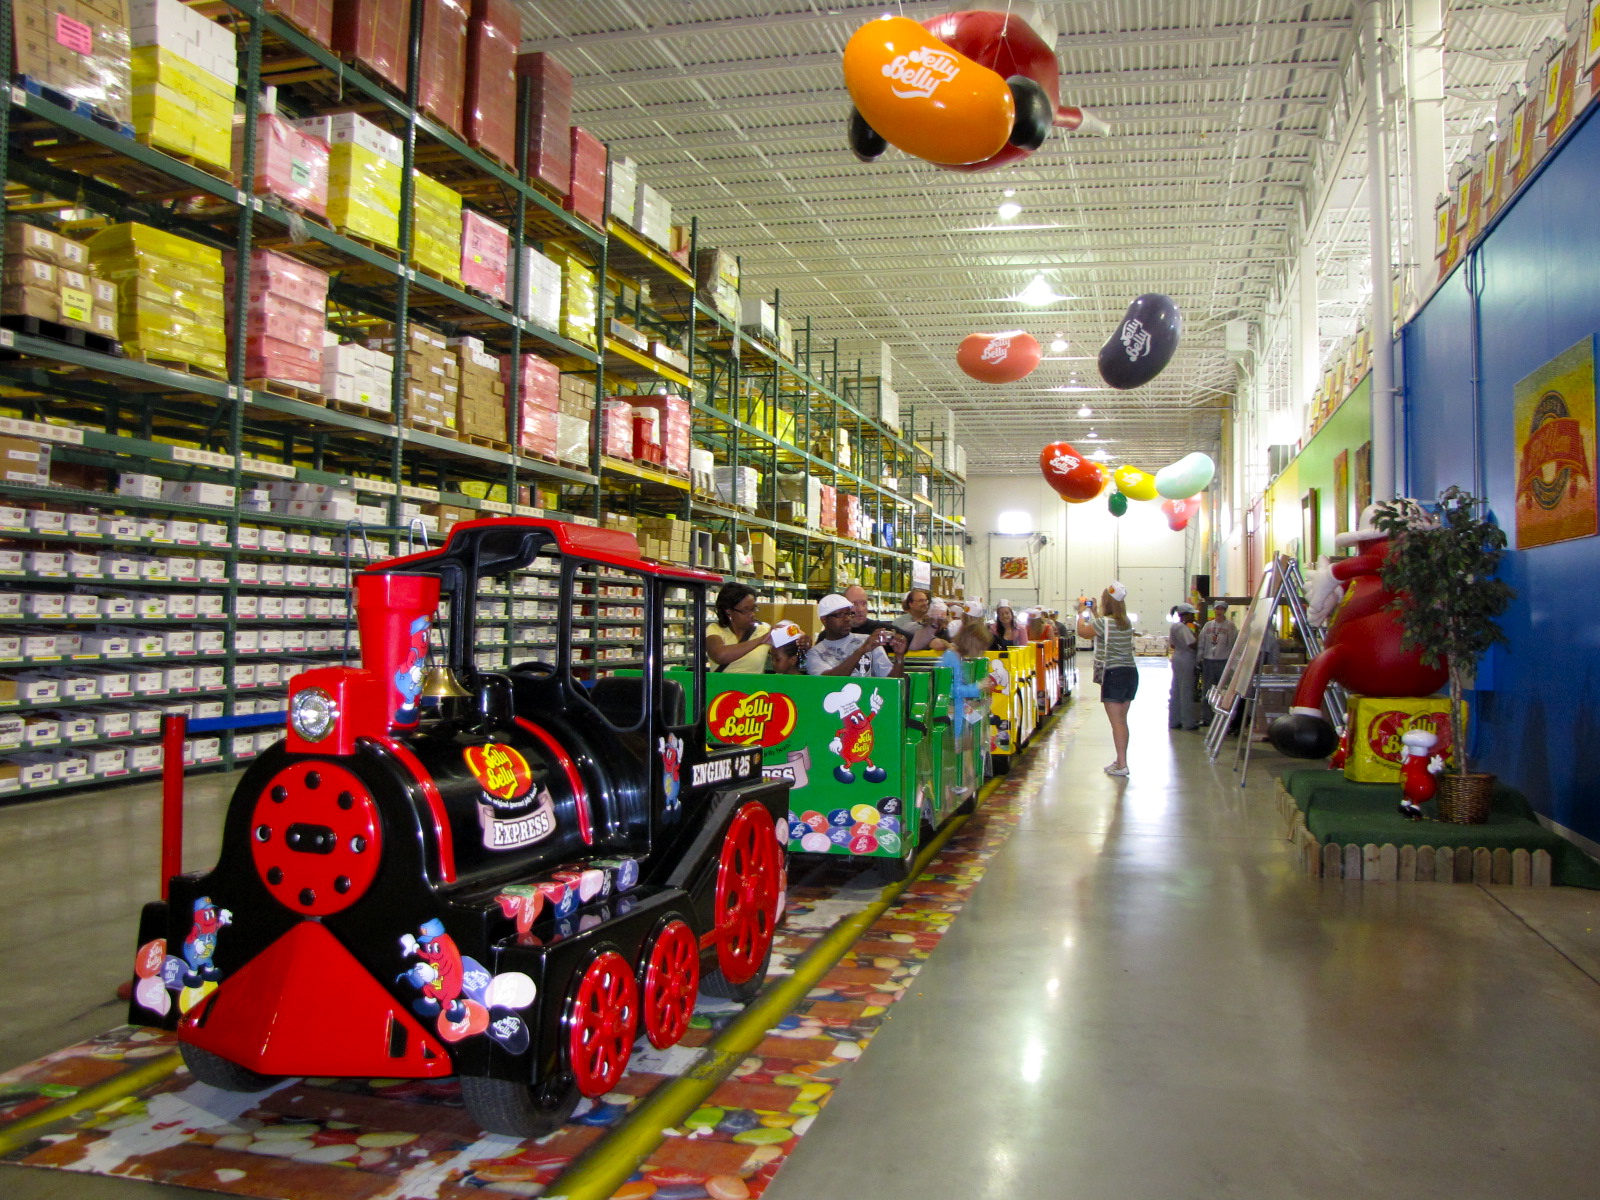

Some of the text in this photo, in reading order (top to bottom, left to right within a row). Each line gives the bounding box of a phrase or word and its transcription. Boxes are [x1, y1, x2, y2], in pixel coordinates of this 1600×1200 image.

[881, 55, 941, 98] Belly
[908, 46, 960, 82] Jelly
[1120, 319, 1143, 347] Jelly
[1126, 329, 1151, 362] Belly
[980, 346, 1008, 364] Belly
[733, 691, 774, 722] Jelly
[719, 716, 764, 745] Belly
[481, 743, 513, 769] Jelly
[486, 766, 518, 799] Belly
[692, 758, 732, 787] ENGINE
[734, 755, 751, 777] #25
[493, 811, 549, 846] EXPRESS
[463, 971, 480, 991] Belly
[472, 969, 489, 989] Jelly
[493, 1020, 513, 1039] Belly
[503, 1016, 521, 1034] Jelly
